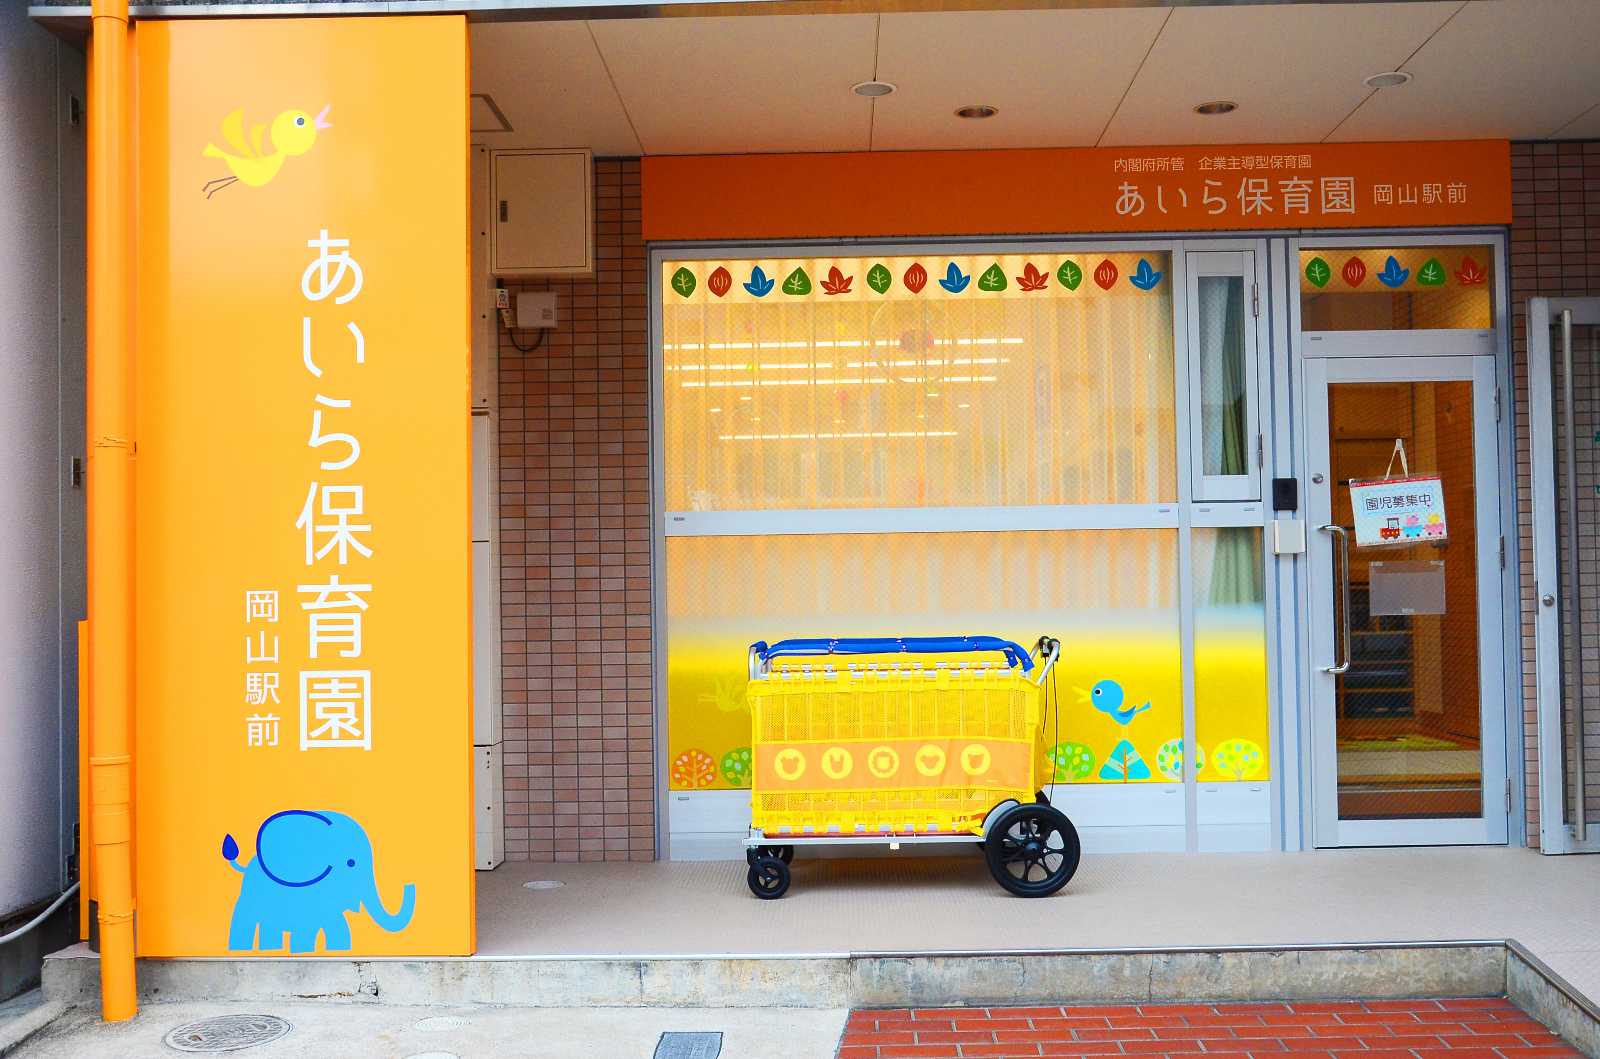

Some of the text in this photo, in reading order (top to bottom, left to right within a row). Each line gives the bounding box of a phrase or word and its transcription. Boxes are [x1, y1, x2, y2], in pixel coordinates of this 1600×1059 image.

[1114, 155, 1312, 172] 内閣府所管 企業主導型保育園
[1115, 176, 1468, 217] あいら保育園 岡山駅前
[296, 228, 374, 752] あいら保育園
[1366, 494, 1431, 510] 園児募集中
[245, 589, 281, 747] 岡山駅前
